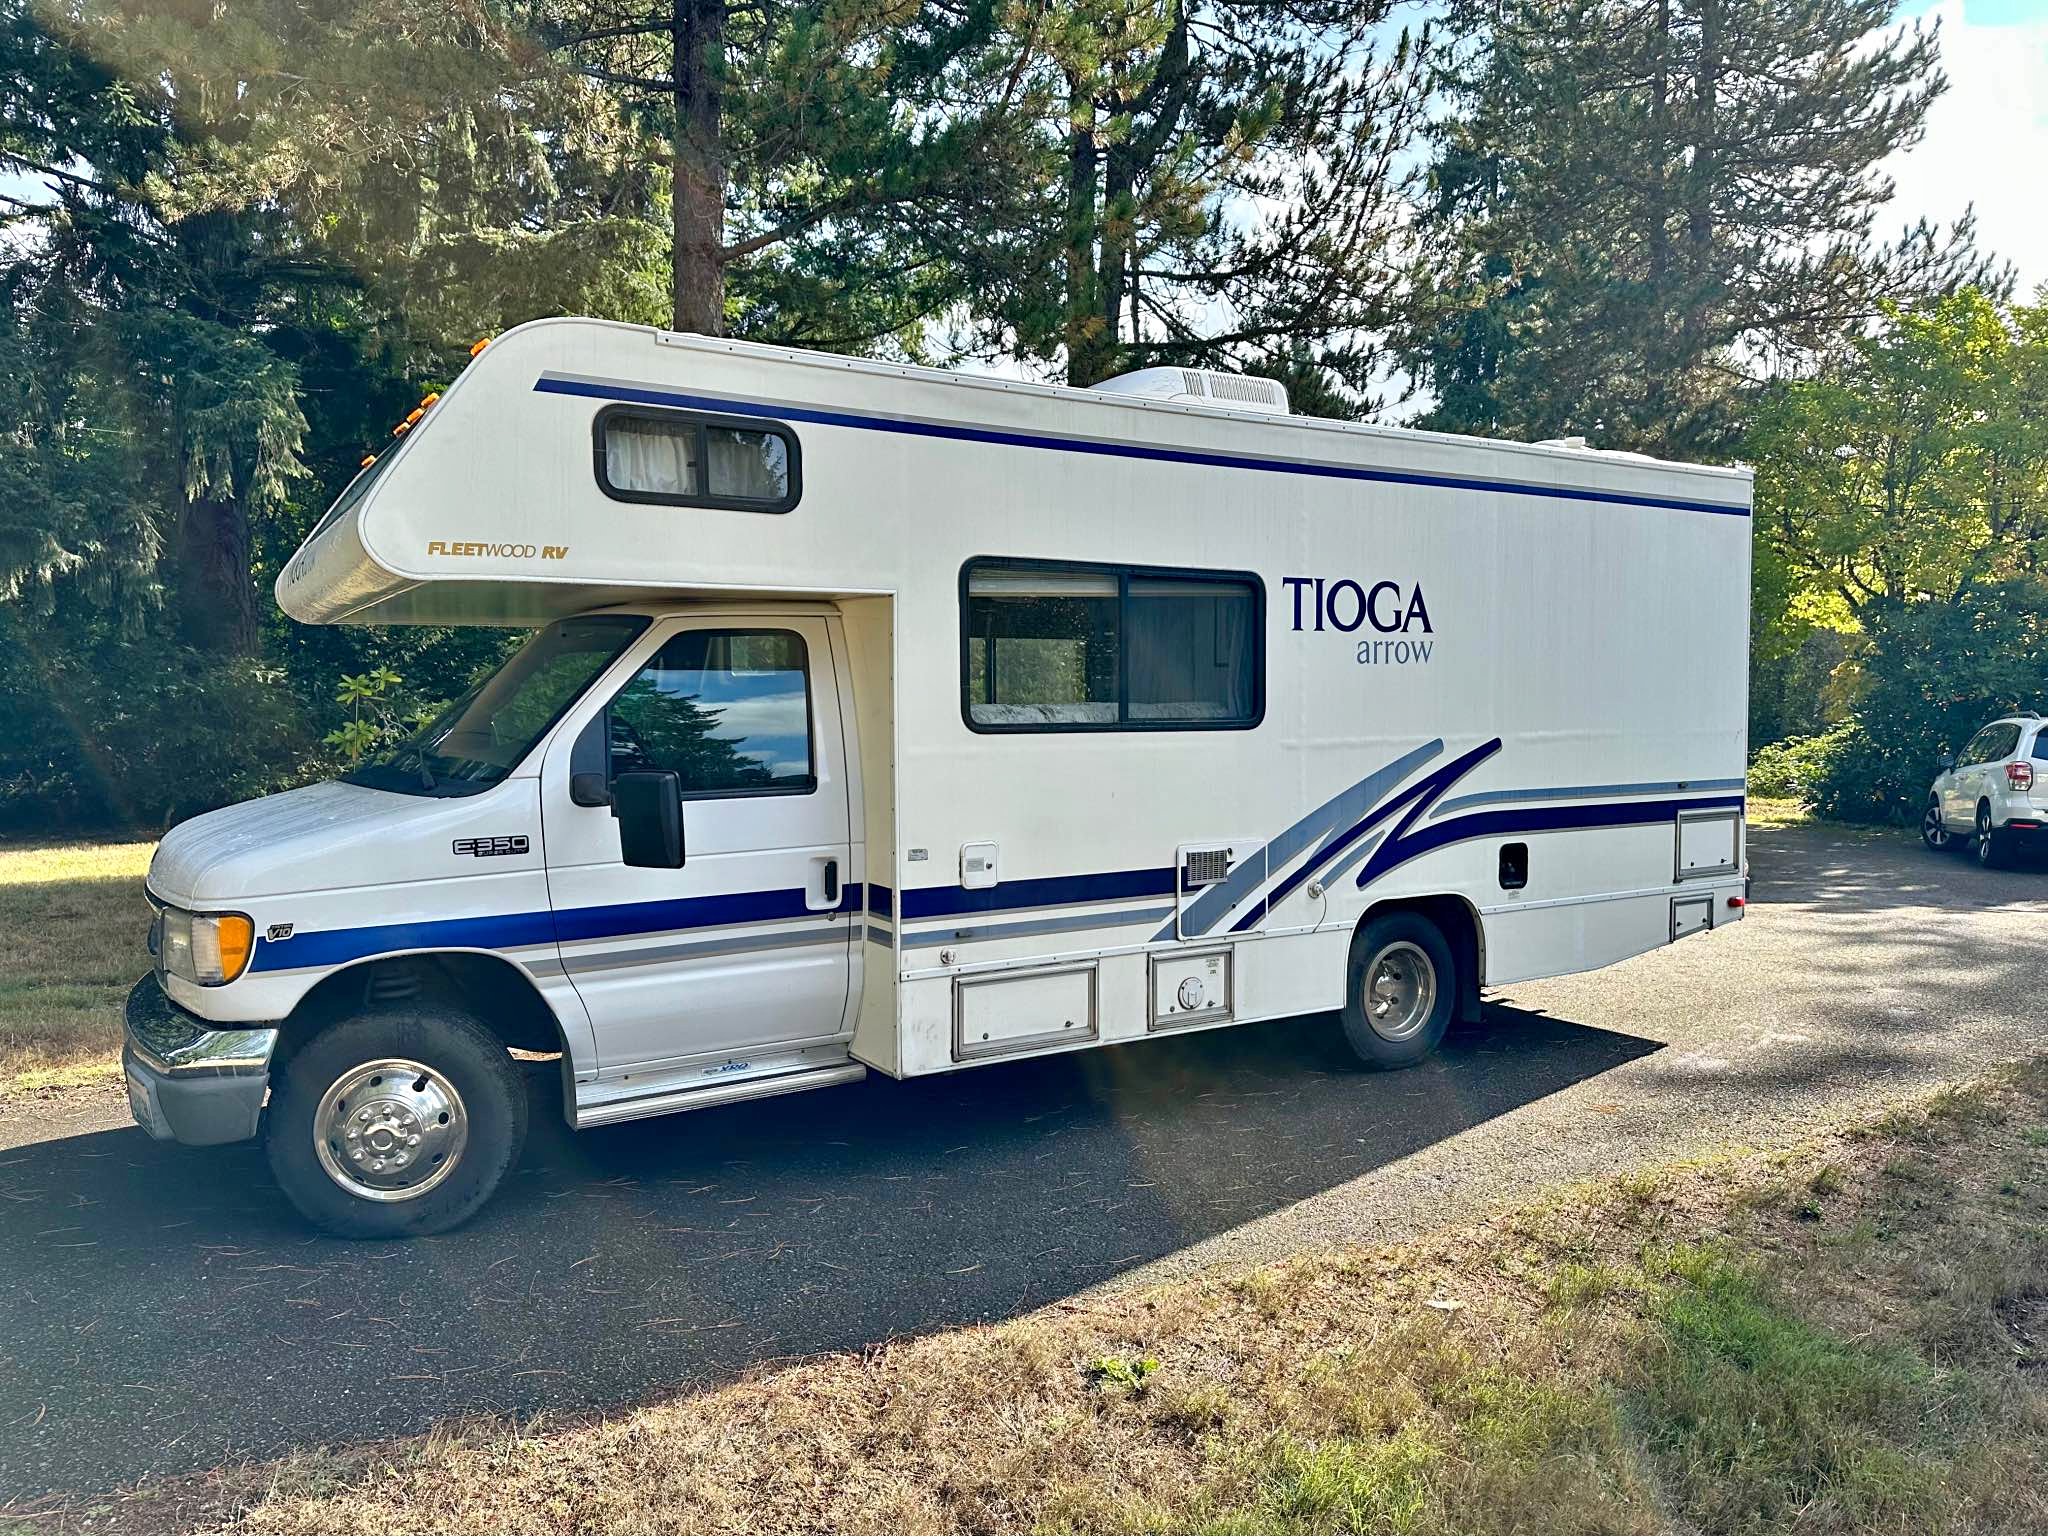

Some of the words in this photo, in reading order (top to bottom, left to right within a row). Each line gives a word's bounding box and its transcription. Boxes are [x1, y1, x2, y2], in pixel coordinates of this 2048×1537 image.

[428, 541, 536, 558] FLEETWOOD
[541, 546, 569, 559] RV
[1282, 576, 1434, 633] TIOGA
[1357, 641, 1433, 664] arrow
[269, 927, 291, 940] V10
